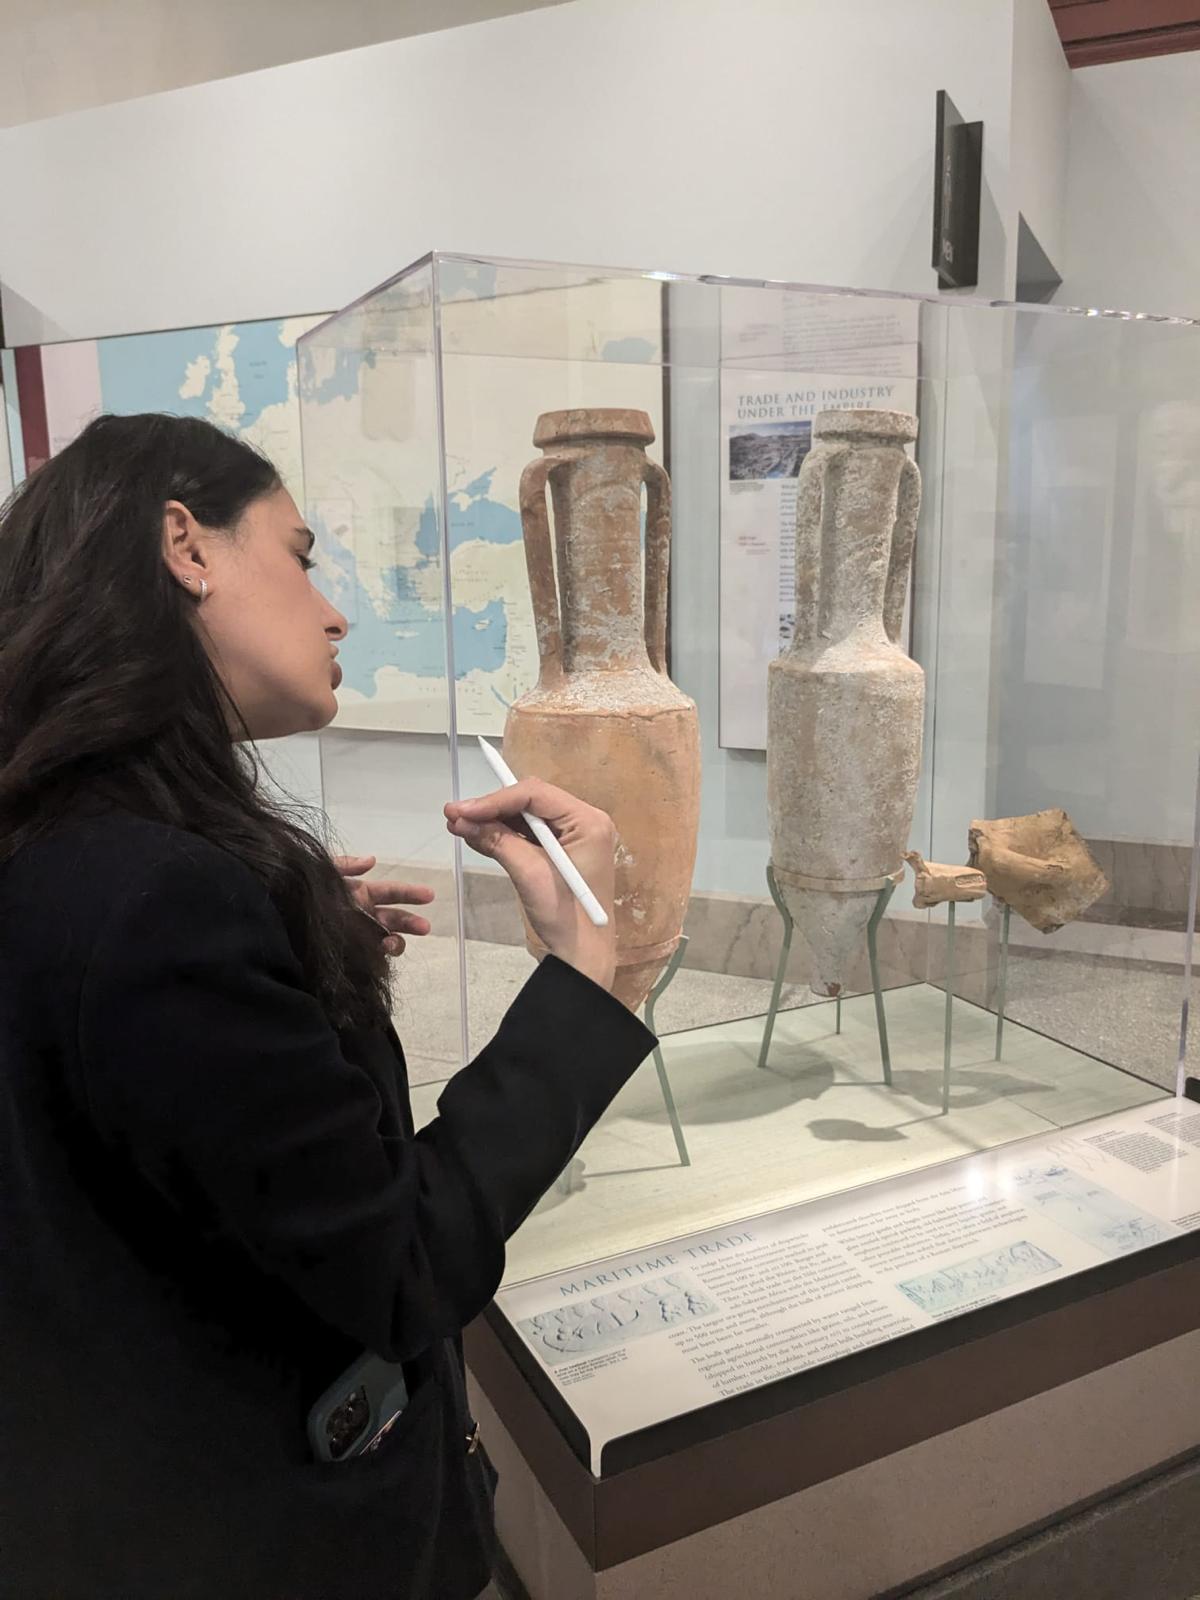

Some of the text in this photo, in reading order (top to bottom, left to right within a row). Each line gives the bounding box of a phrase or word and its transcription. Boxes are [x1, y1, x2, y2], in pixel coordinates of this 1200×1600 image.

[738, 385, 893, 406] TRADE AND INDUSTRY
[737, 407, 784, 419] UNDER
[790, 404, 816, 416] THE
[560, 1232, 756, 1296] MARITIME TRADE
